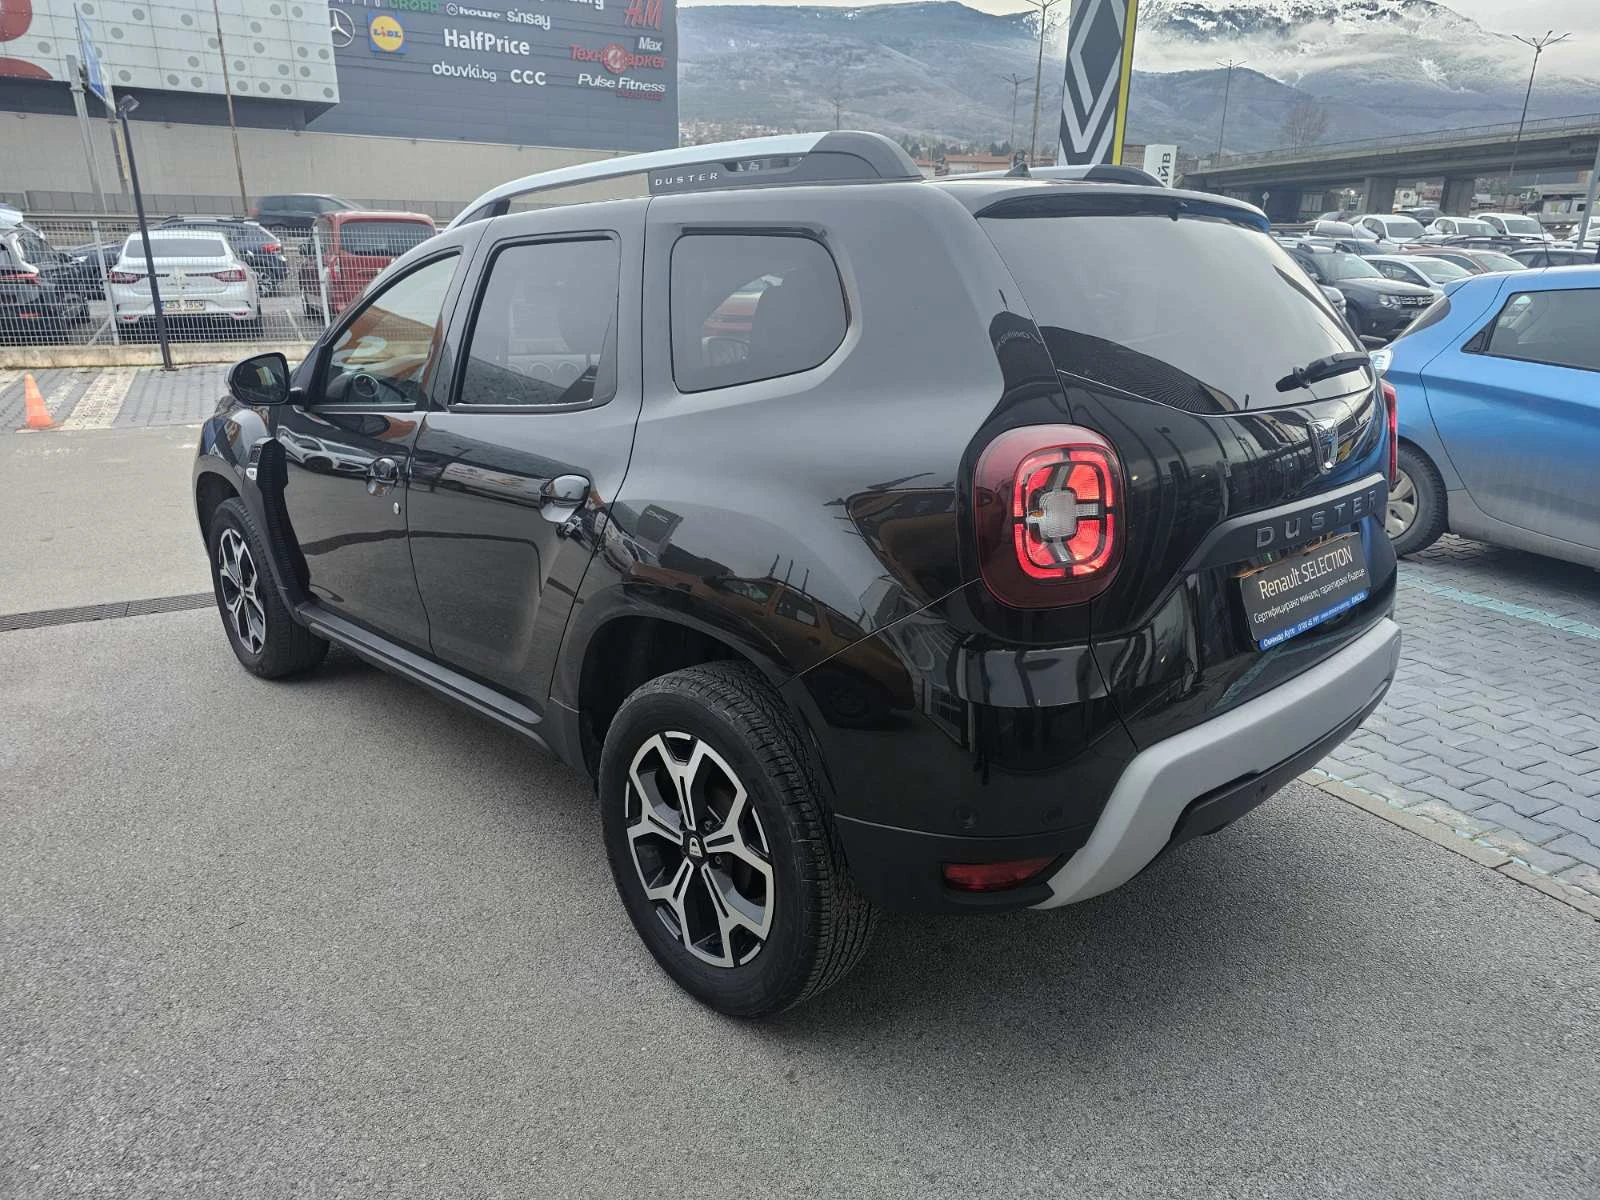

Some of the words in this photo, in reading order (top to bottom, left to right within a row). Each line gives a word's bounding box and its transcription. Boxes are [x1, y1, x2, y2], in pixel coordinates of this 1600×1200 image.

[506, 8, 551, 30] sinsay
[443, 28, 530, 55] HalfPrice
[638, 36, 663, 51] Max
[432, 60, 497, 82] obuvki.bg
[510, 69, 547, 85] CCC
[578, 73, 615, 88] Pulse
[617, 77, 666, 92] Fitness
[655, 172, 718, 186] DUSTER
[1256, 490, 1377, 547] DUSTER
[1258, 567, 1302, 599] Renault
[1301, 546, 1353, 583] SELECTION
